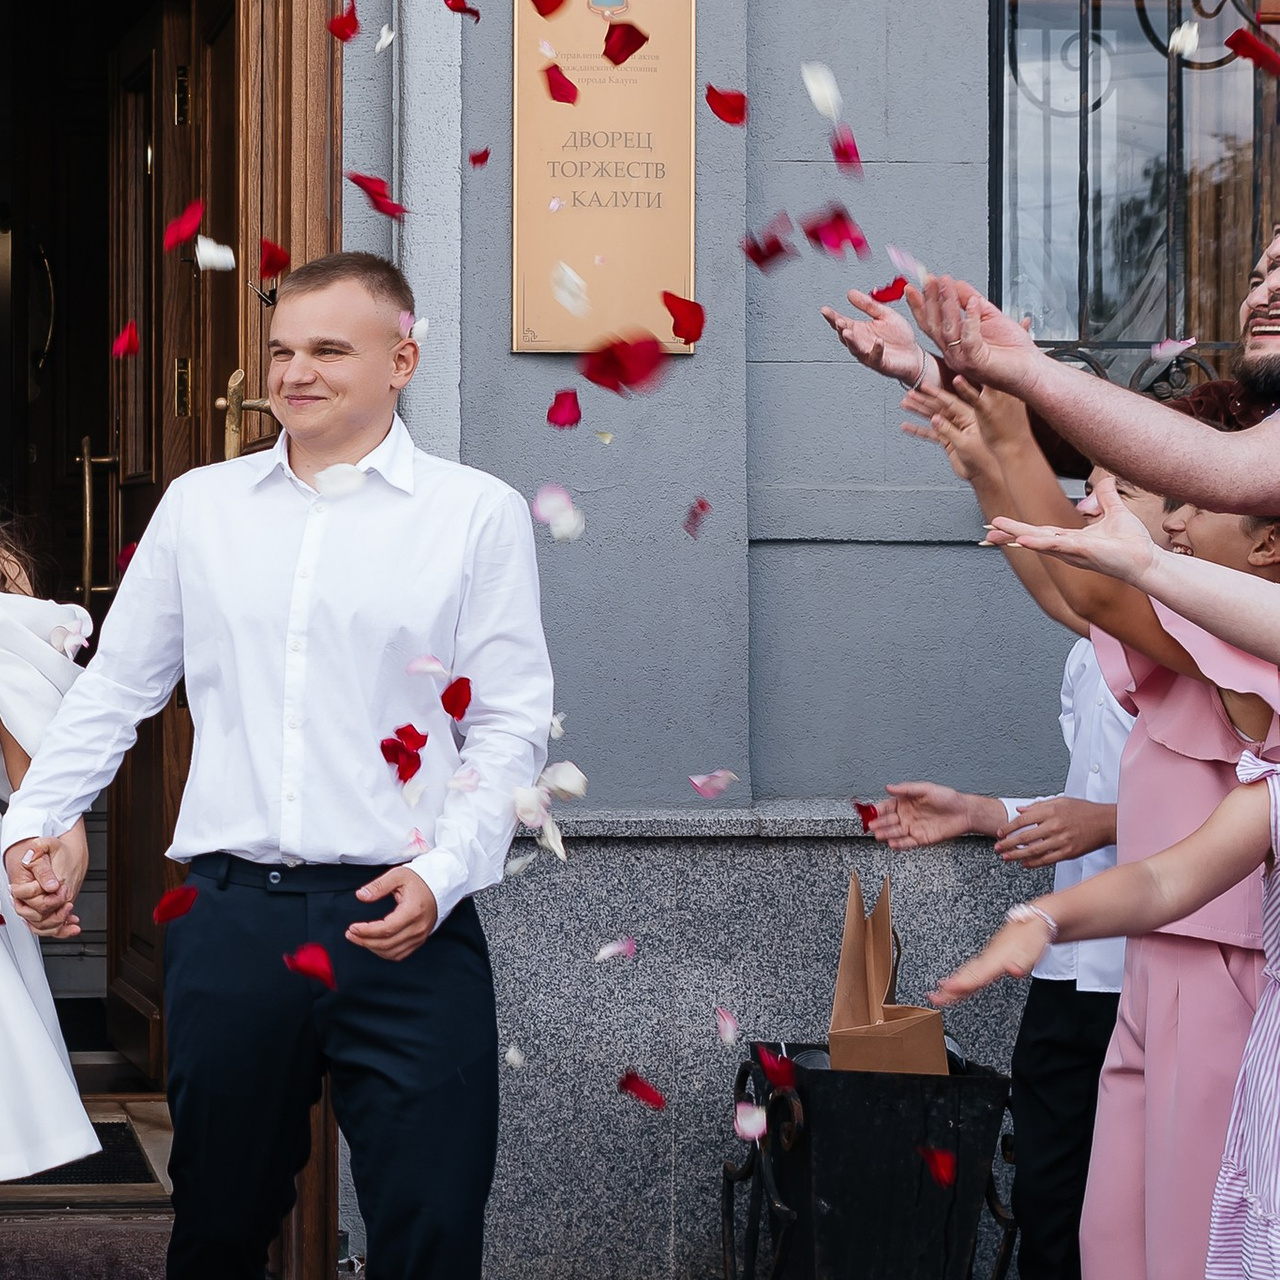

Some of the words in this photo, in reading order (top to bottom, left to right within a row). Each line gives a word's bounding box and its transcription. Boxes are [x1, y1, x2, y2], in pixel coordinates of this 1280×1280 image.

[554, 51, 603, 61] Управлени
[638, 53, 660, 61] актов
[559, 65, 616, 73] ражданского
[616, 65, 658, 73] состояния
[577, 77, 606, 86] города
[608, 76, 638, 86] Калуги
[561, 131, 653, 153] ДВОРЕЦ
[546, 160, 666, 179] ТОРЖЕСТВ
[571, 190, 662, 209] КАЛУГИ
